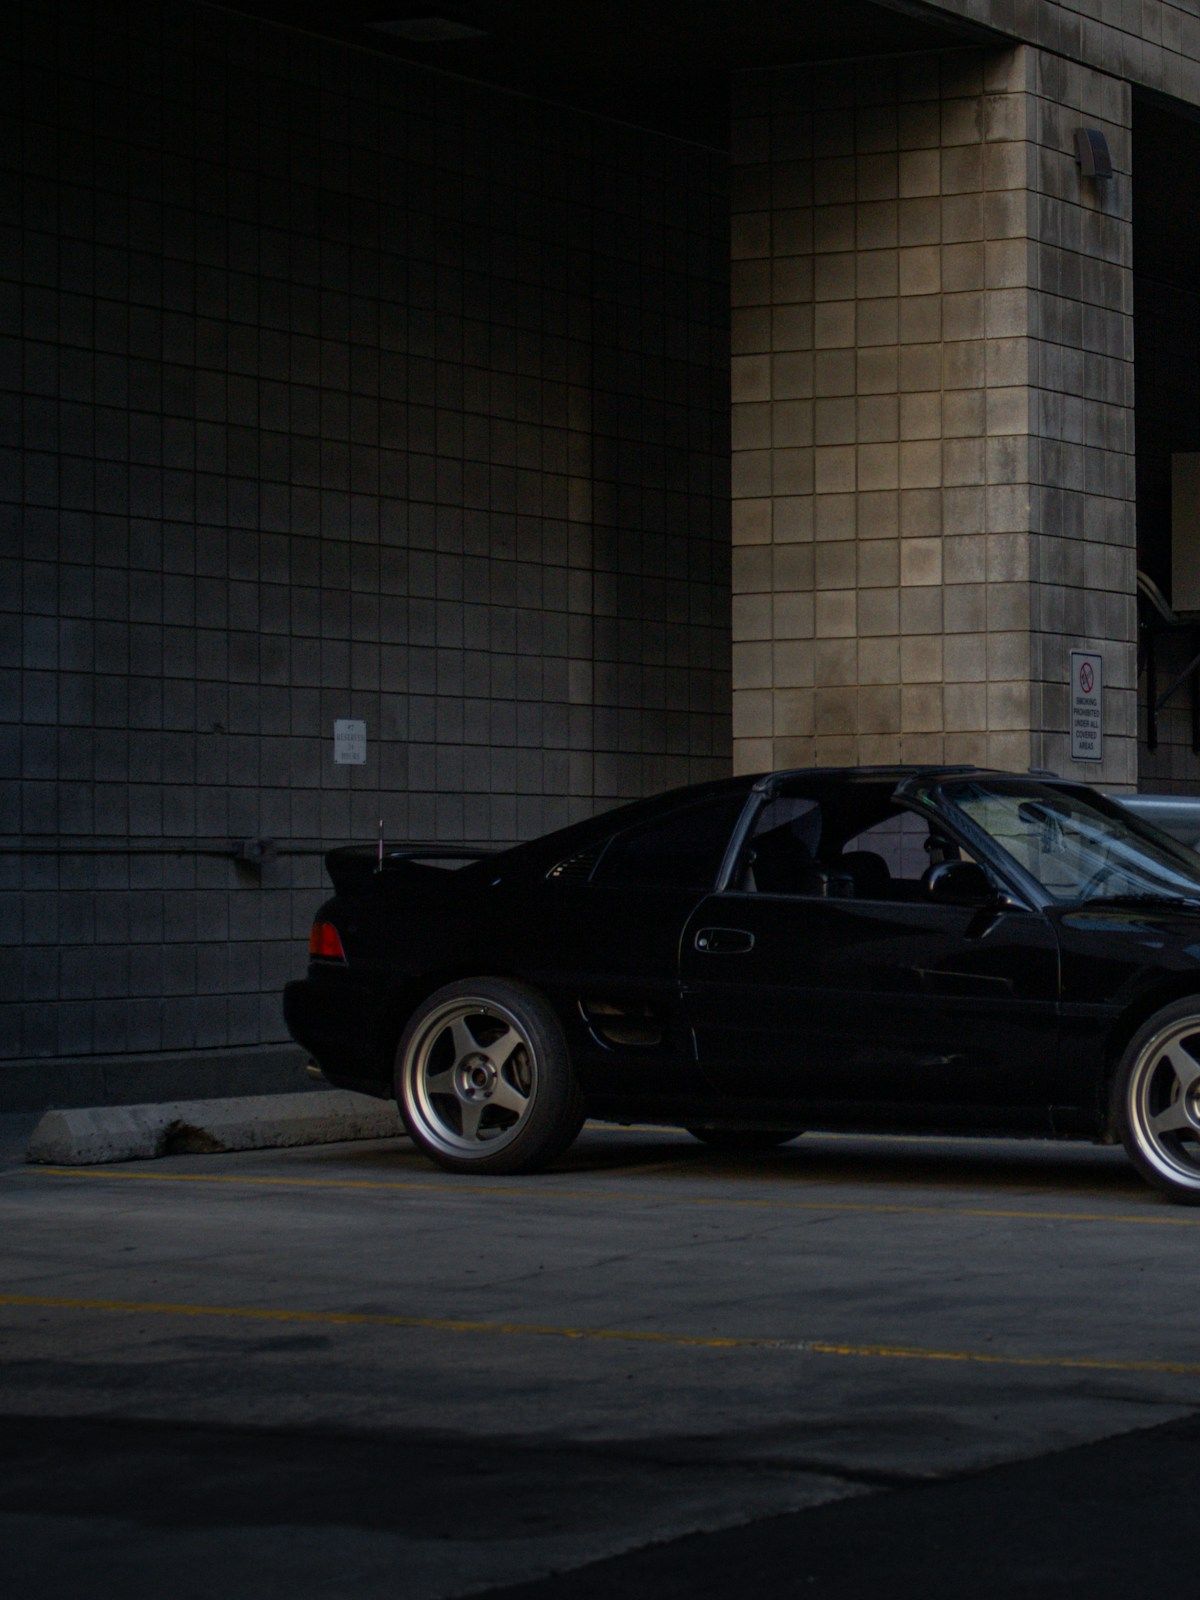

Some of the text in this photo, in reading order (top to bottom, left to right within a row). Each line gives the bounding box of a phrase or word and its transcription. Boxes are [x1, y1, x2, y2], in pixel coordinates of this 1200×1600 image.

[1076, 697, 1097, 706] SMOKING
[1074, 708, 1100, 717] PROHIBITED
[1074, 719, 1098, 728] UNDER ALL
[1076, 730, 1097, 739] COVERED
[1079, 741, 1093, 750] AREAS
